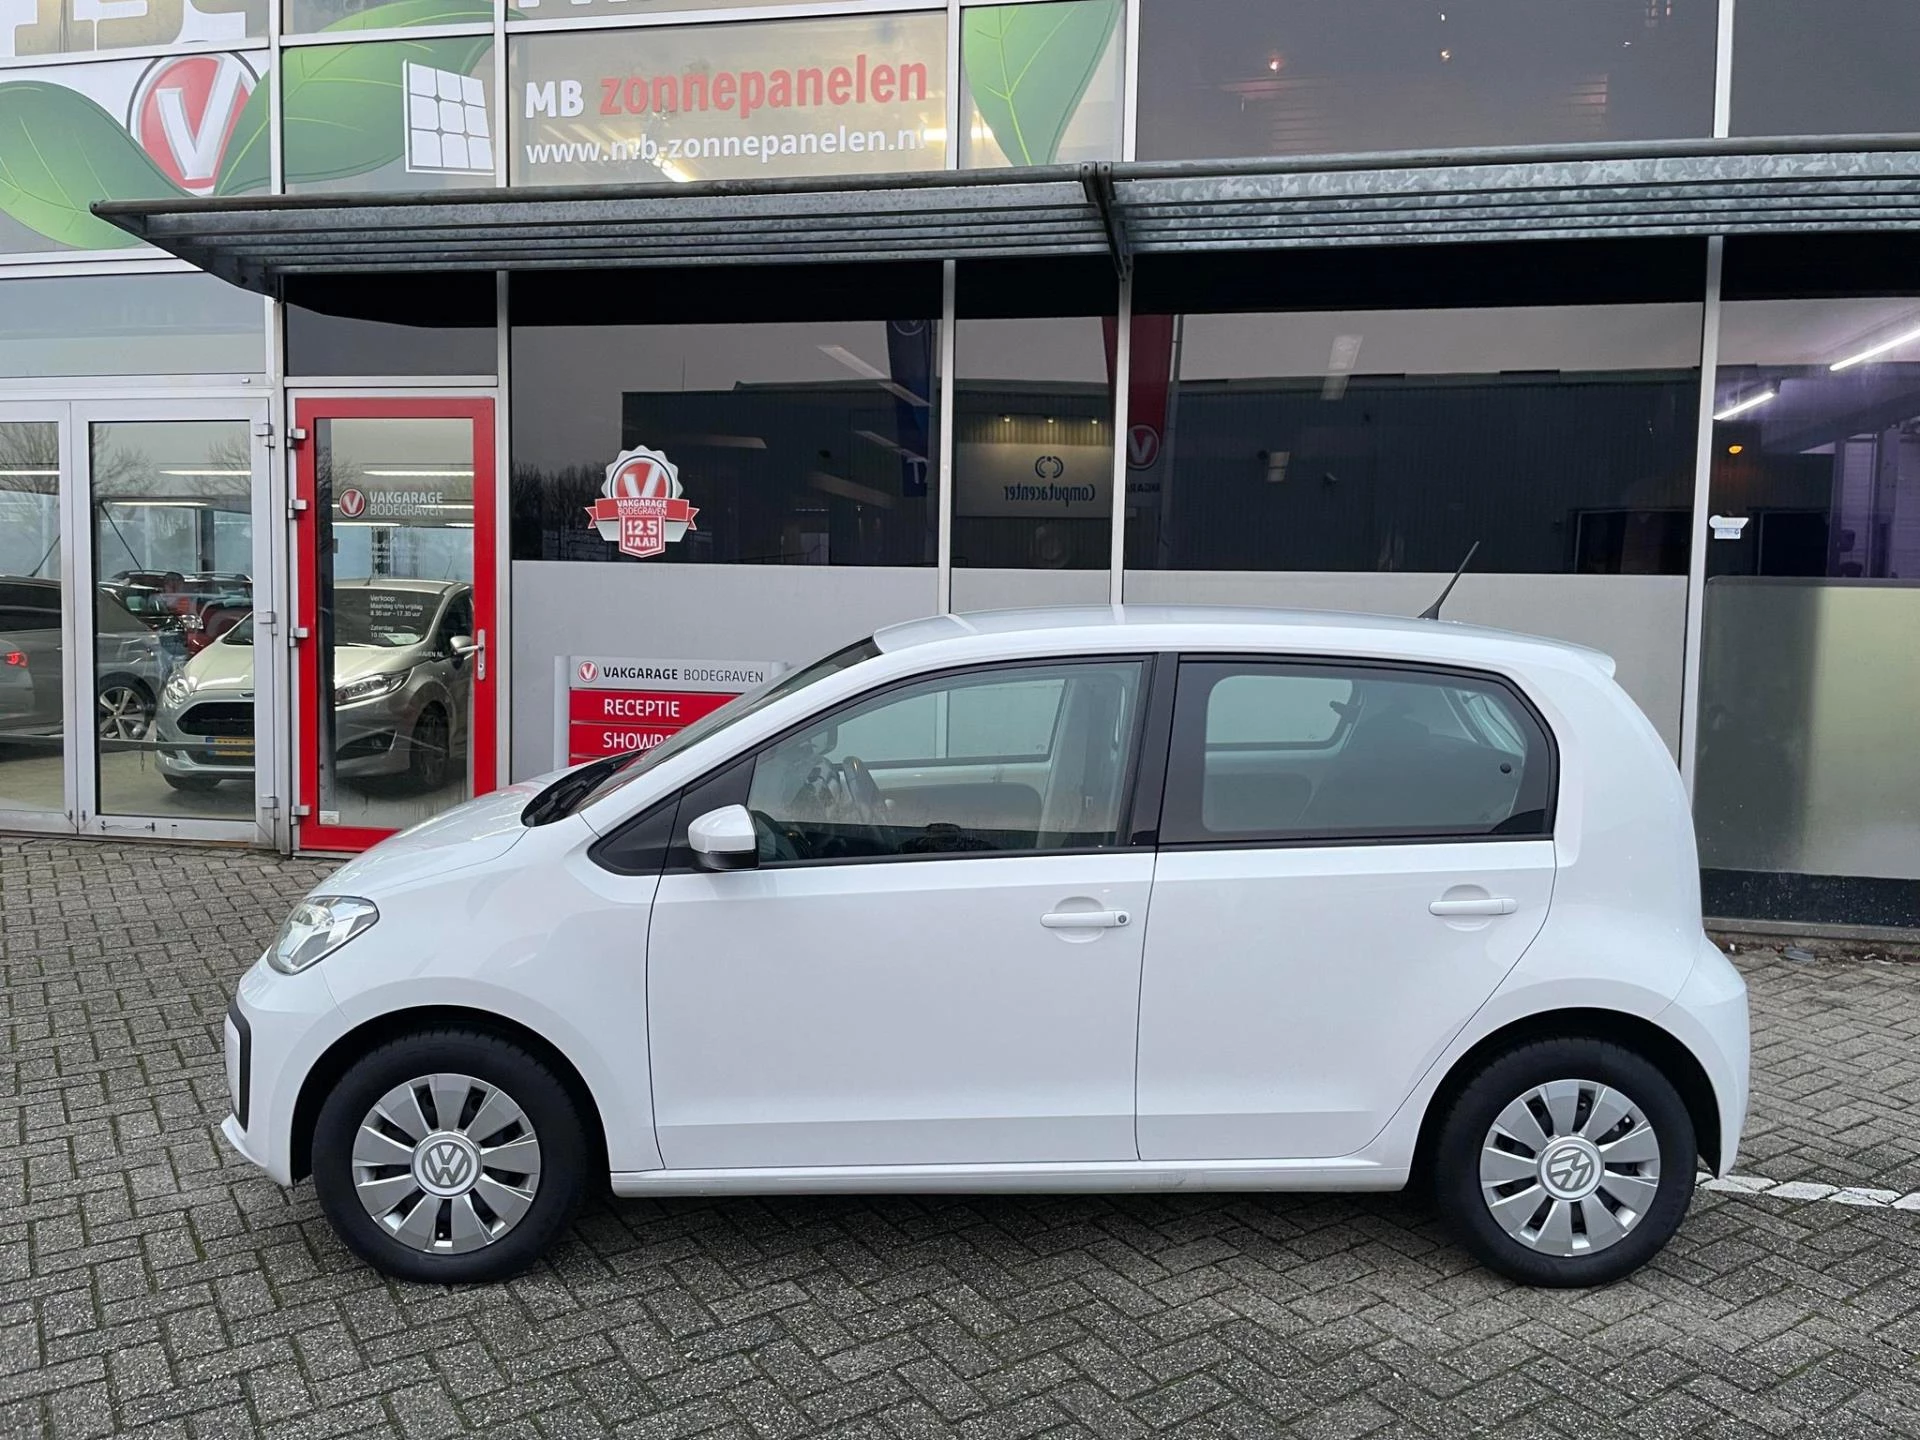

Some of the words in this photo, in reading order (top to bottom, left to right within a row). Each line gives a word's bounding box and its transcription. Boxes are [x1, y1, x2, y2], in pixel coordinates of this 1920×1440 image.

[525, 80, 585, 119] MB
[600, 54, 928, 119] zonnepanelen
[525, 123, 926, 165] www.mb-zonnepanelen.nl
[369, 491, 443, 504] VAKGARAGE
[369, 503, 444, 516] BODEGRAVEN
[618, 507, 667, 516] BODEGRAVEN
[626, 520, 658, 536] 12.5
[626, 537, 658, 547] JAAR
[603, 666, 679, 681] VAKGARAGE
[683, 668, 764, 683] BODEGRAVEN
[603, 698, 681, 718] RECEPTIE
[602, 731, 673, 749] SHOWR
